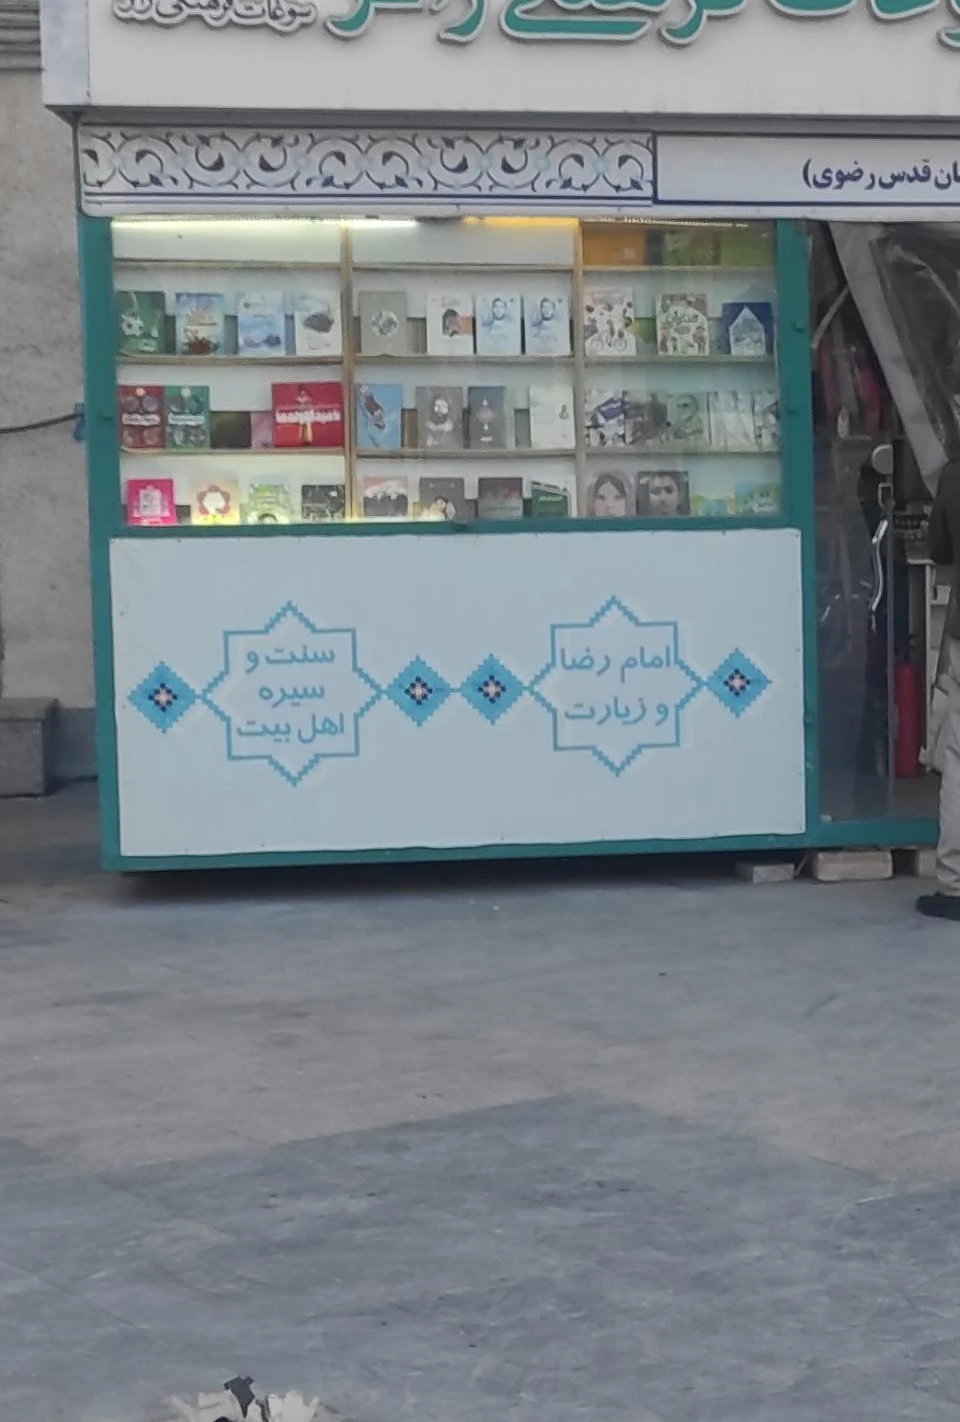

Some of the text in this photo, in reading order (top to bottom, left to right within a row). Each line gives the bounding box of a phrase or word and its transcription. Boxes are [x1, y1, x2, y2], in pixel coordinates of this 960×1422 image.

[801, 158, 876, 190] رضوی)
[878, 158, 932, 189] قدس
[264, 644, 335, 666] سنت
[559, 647, 671, 681] امام رضا
[258, 681, 325, 703] سیره
[237, 712, 344, 744] اهل بیت
[564, 700, 648, 726] زیارت
